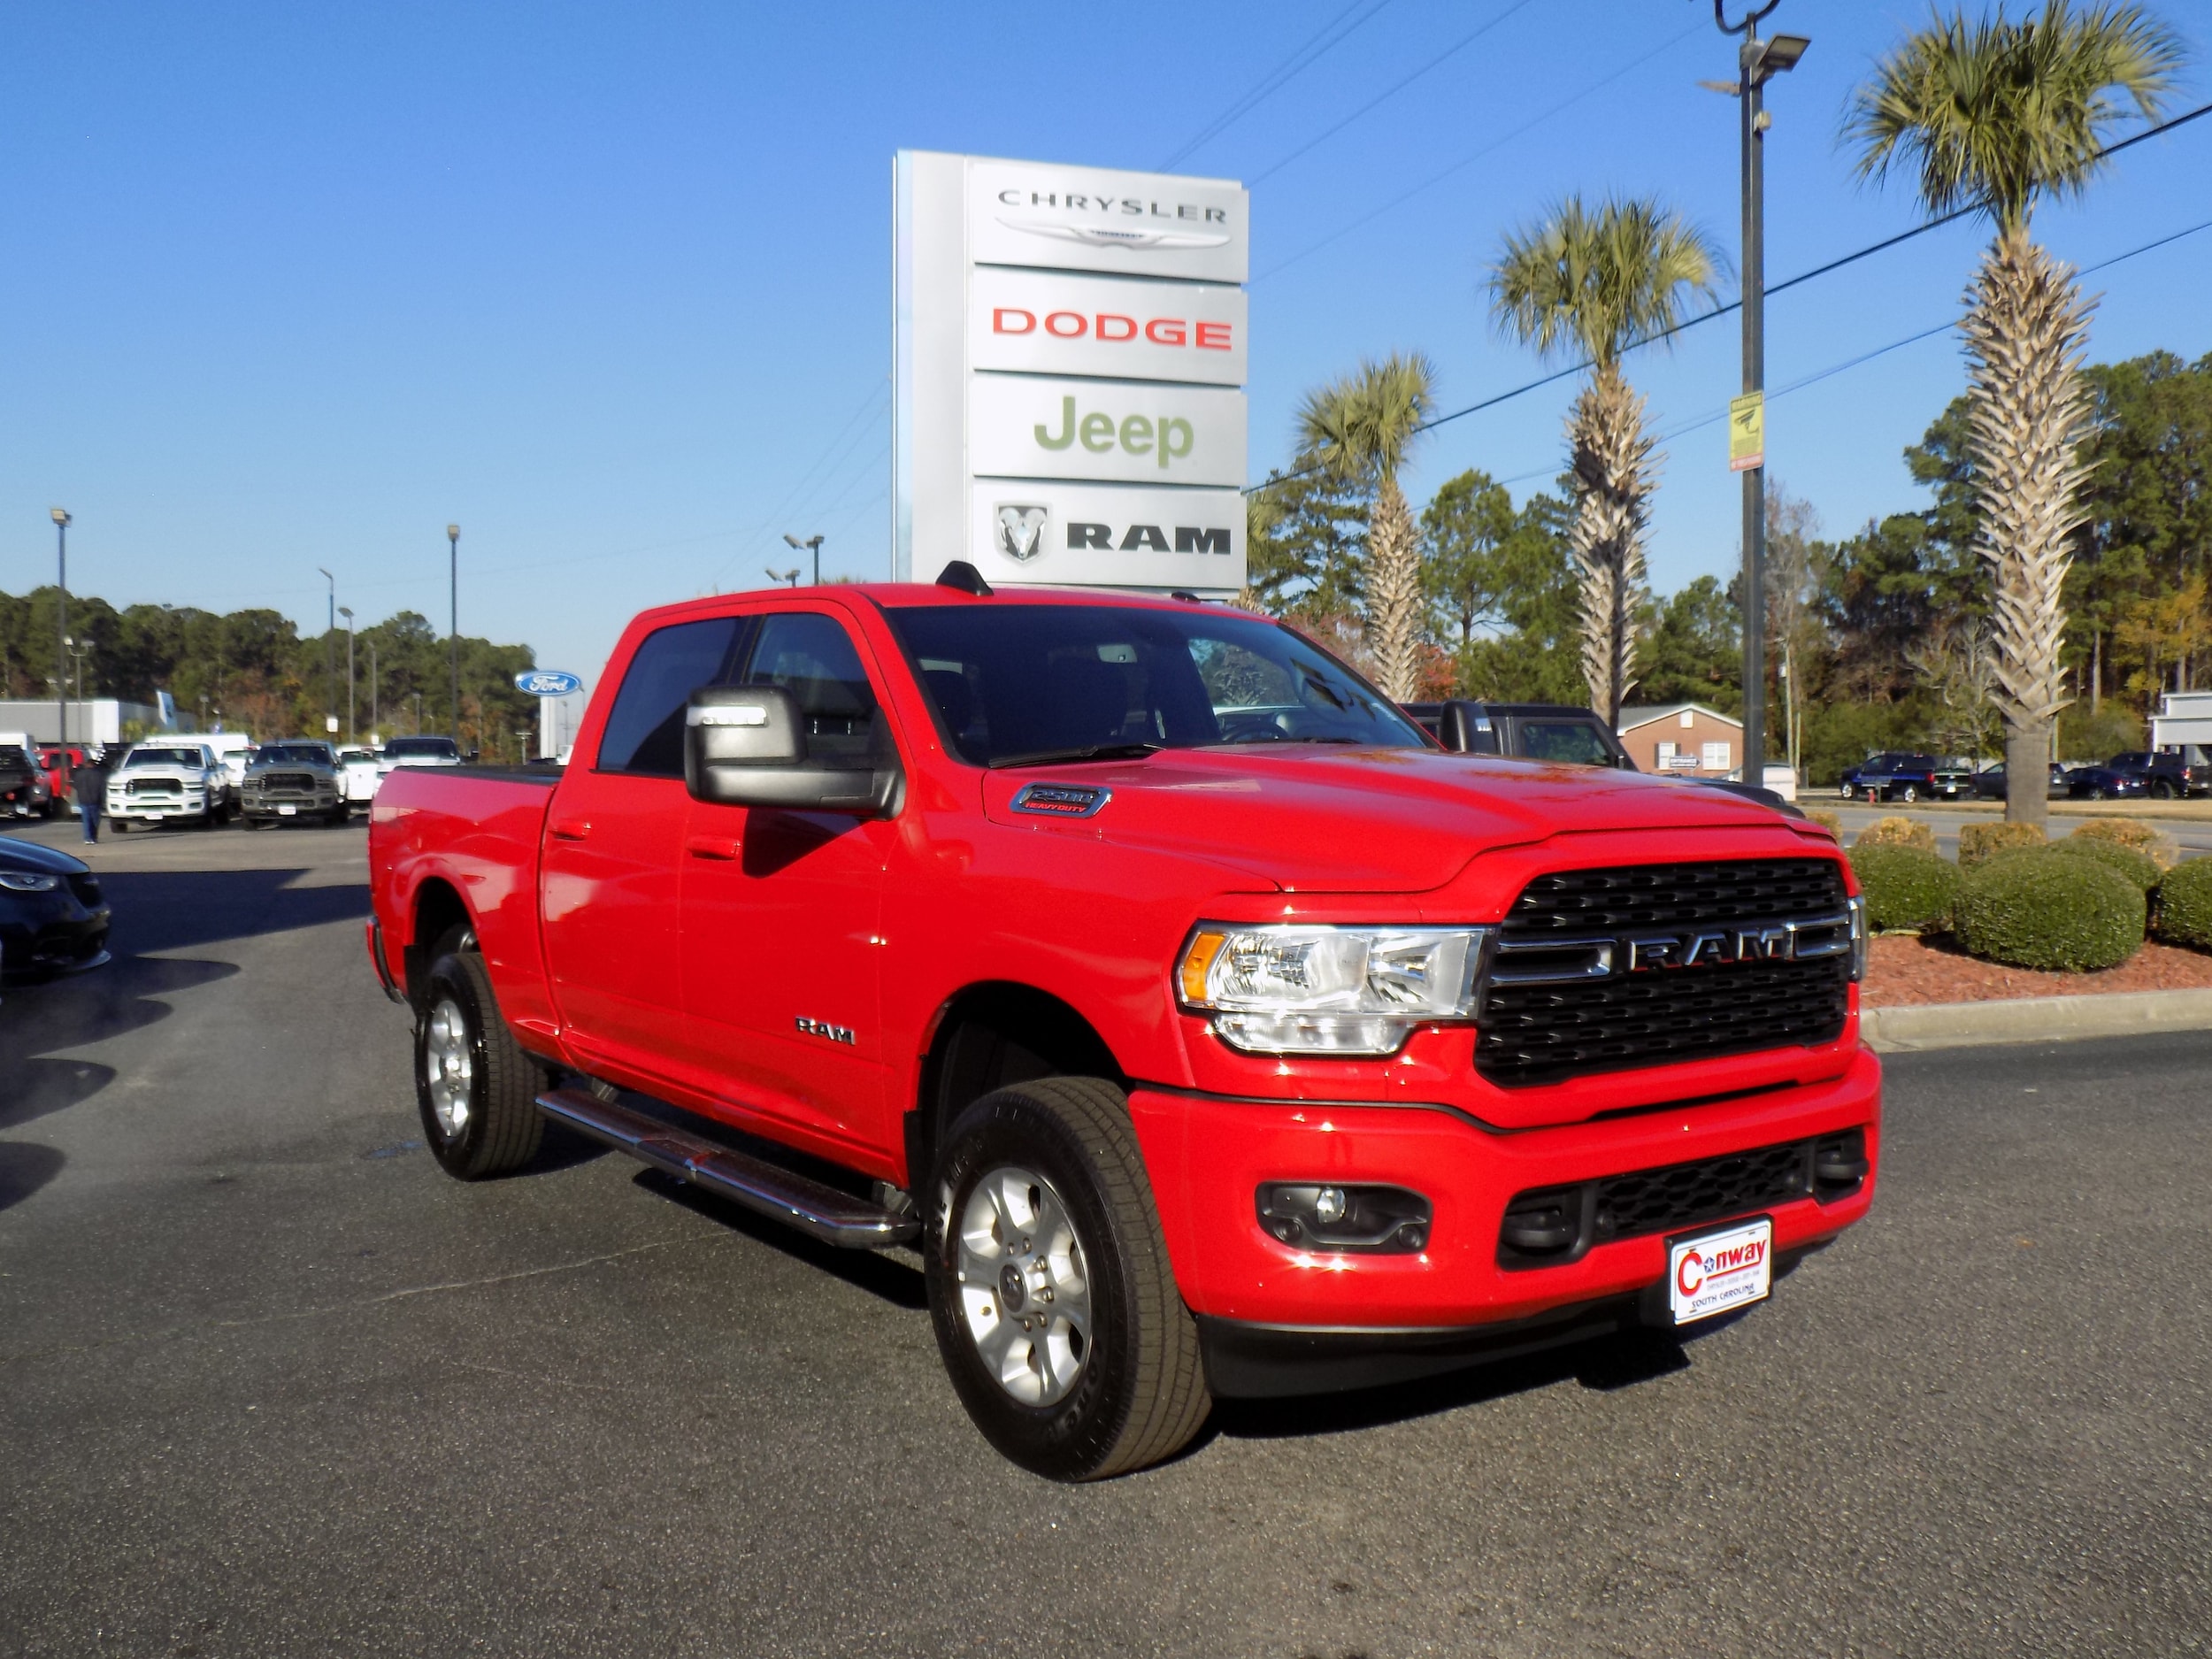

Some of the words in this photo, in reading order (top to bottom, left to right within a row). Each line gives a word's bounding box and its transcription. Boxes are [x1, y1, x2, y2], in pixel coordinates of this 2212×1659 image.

[997, 188, 1227, 224] CHRYSLER
[992, 307, 1233, 351] DODGE
[1033, 396, 1194, 469] Jeep
[1067, 522, 1232, 556] RAM
[529, 675, 568, 691] Ford
[1025, 801, 1058, 811] HEAVY
[1057, 804, 1087, 813] DUTY
[1629, 929, 1785, 972] RAM
[795, 1015, 856, 1046] RAM
[1678, 1239, 1767, 1298] Conway
[1691, 1294, 1717, 1310] SOUTH
[1719, 1282, 1755, 1301] CAROLINA
